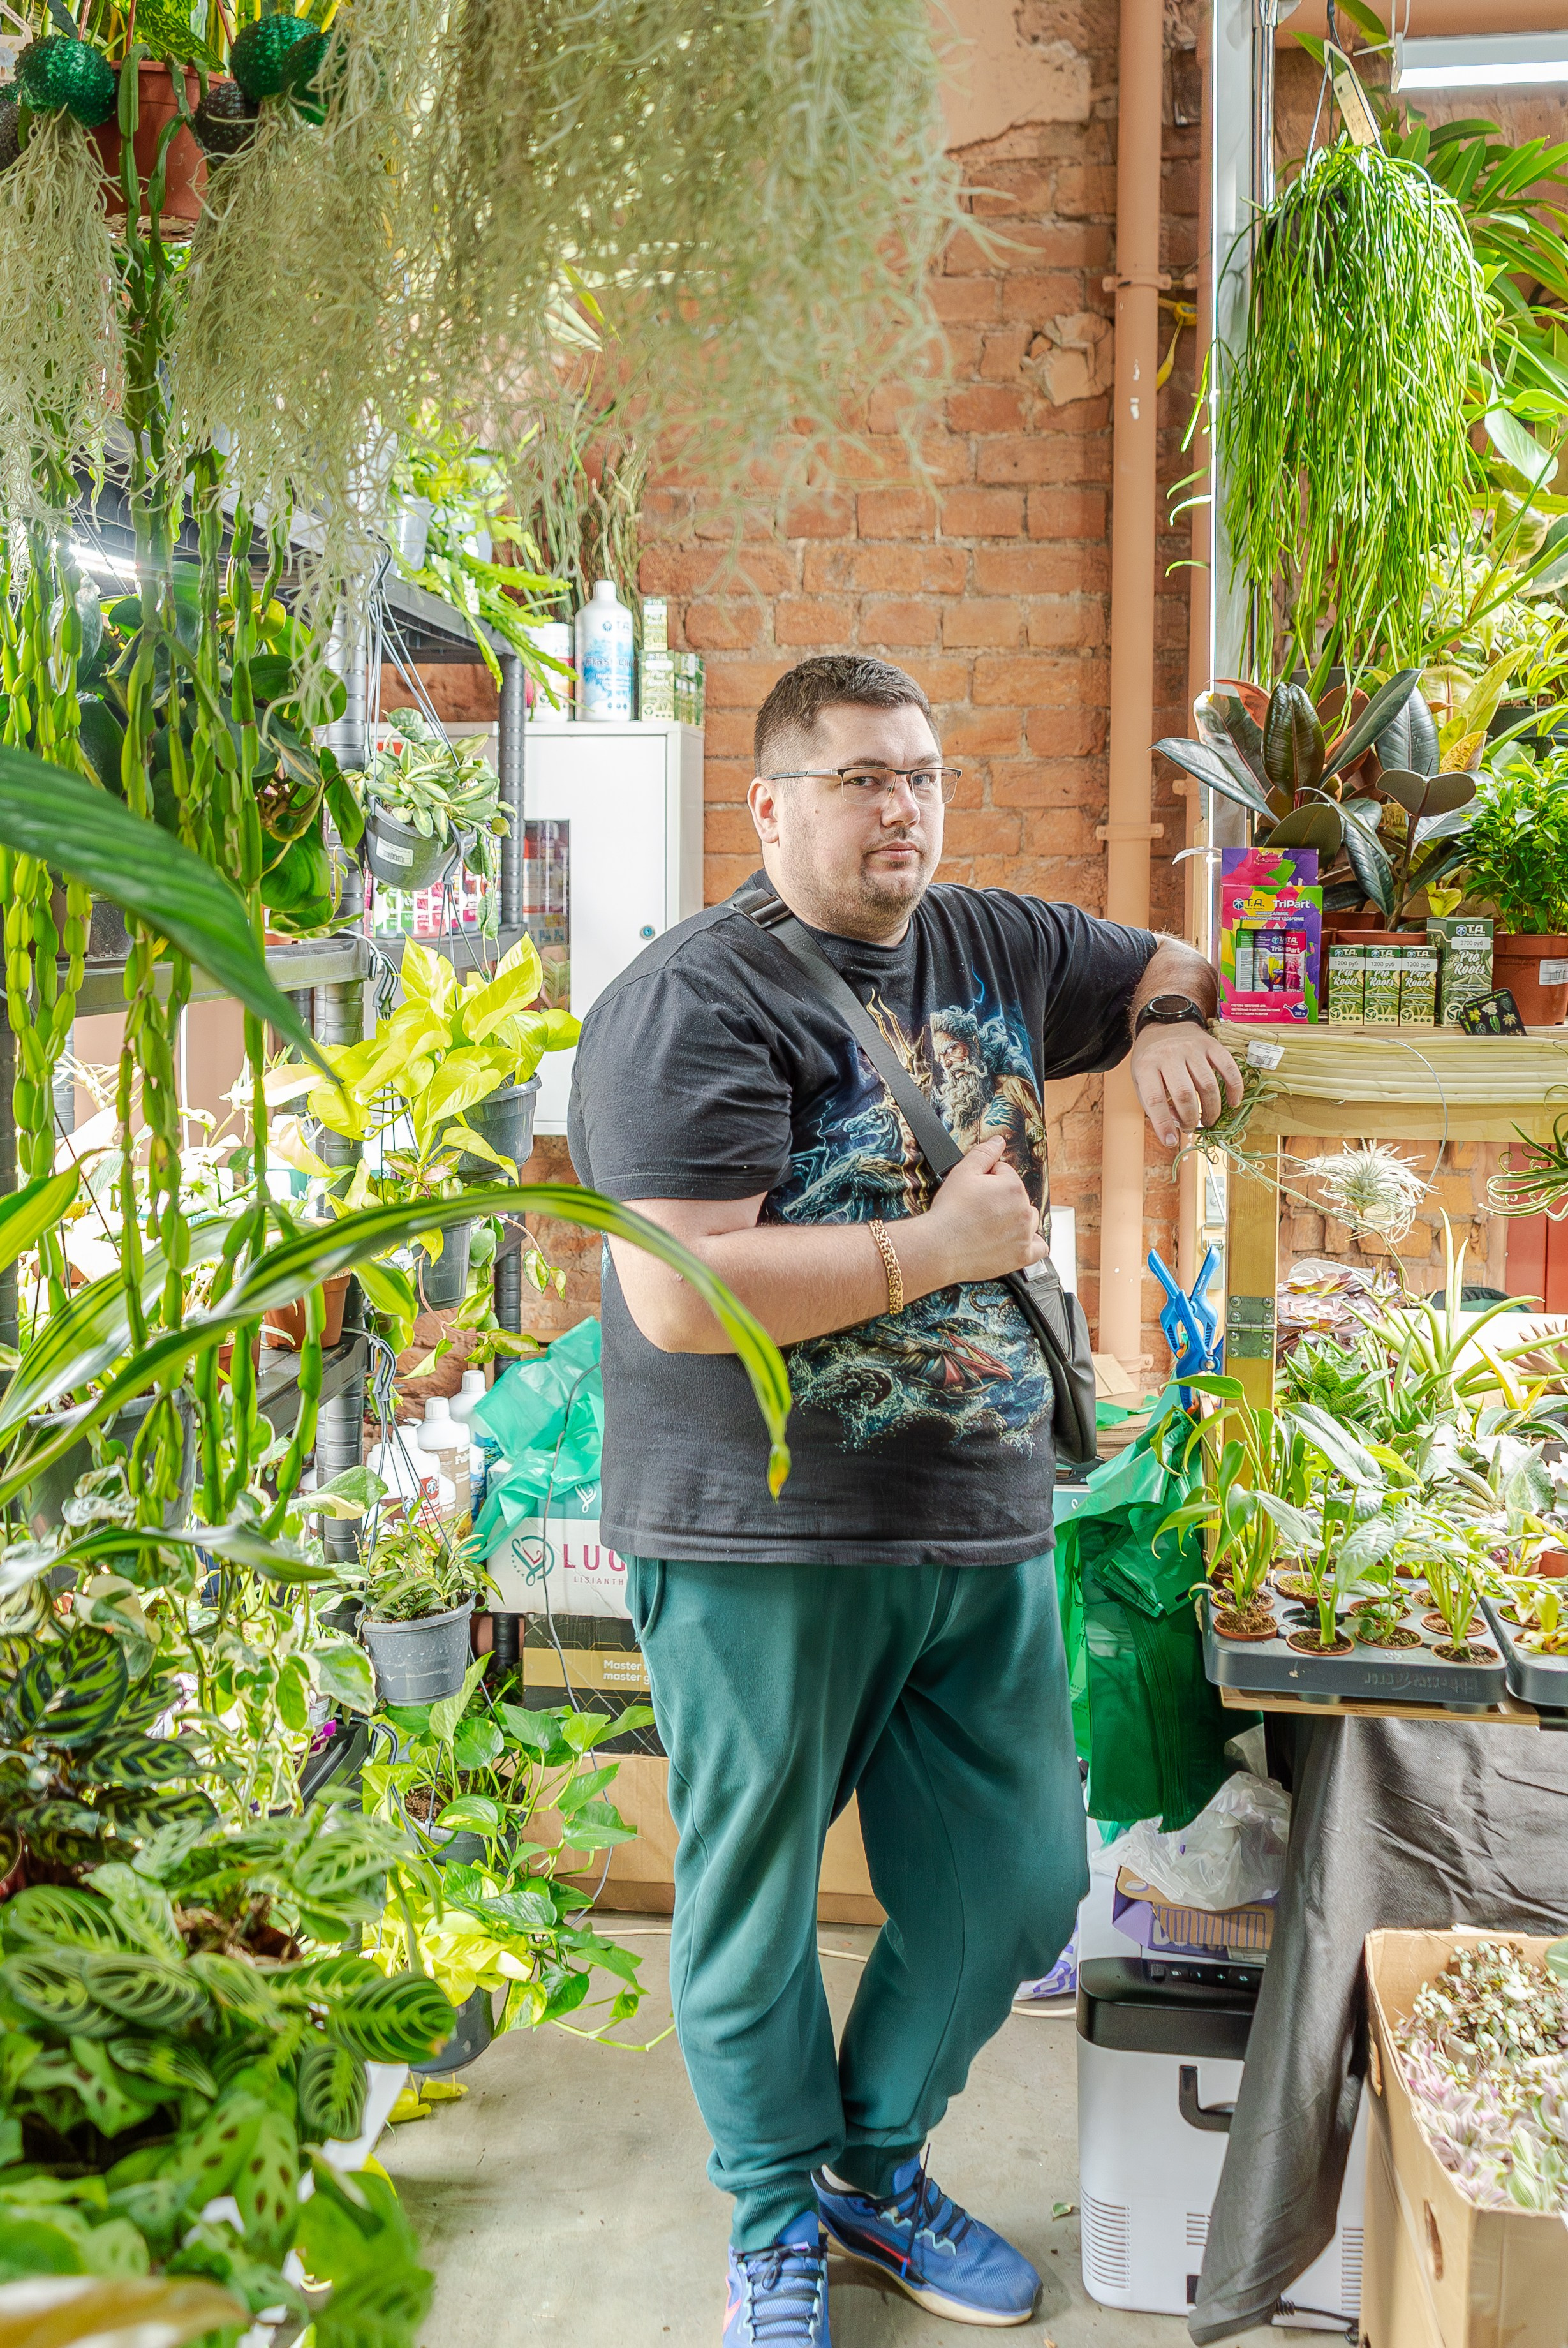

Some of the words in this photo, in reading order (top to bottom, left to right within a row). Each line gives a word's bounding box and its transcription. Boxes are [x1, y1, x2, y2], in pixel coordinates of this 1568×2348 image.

[1273, 900, 1310, 909] TriPart
[1466, 925, 1486, 934] T.A.
[1458, 950, 1481, 962] Pro
[1454, 962, 1486, 976] Roots
[1333, 975, 1358, 986] Roots
[1368, 976, 1394, 987] Roots
[1405, 977, 1430, 988] Roots
[563, 1543, 626, 1572] LUG
[573, 1576, 624, 1586] LISIANTH
[603, 1659, 642, 1670] Master
[603, 1672, 642, 1681] master
